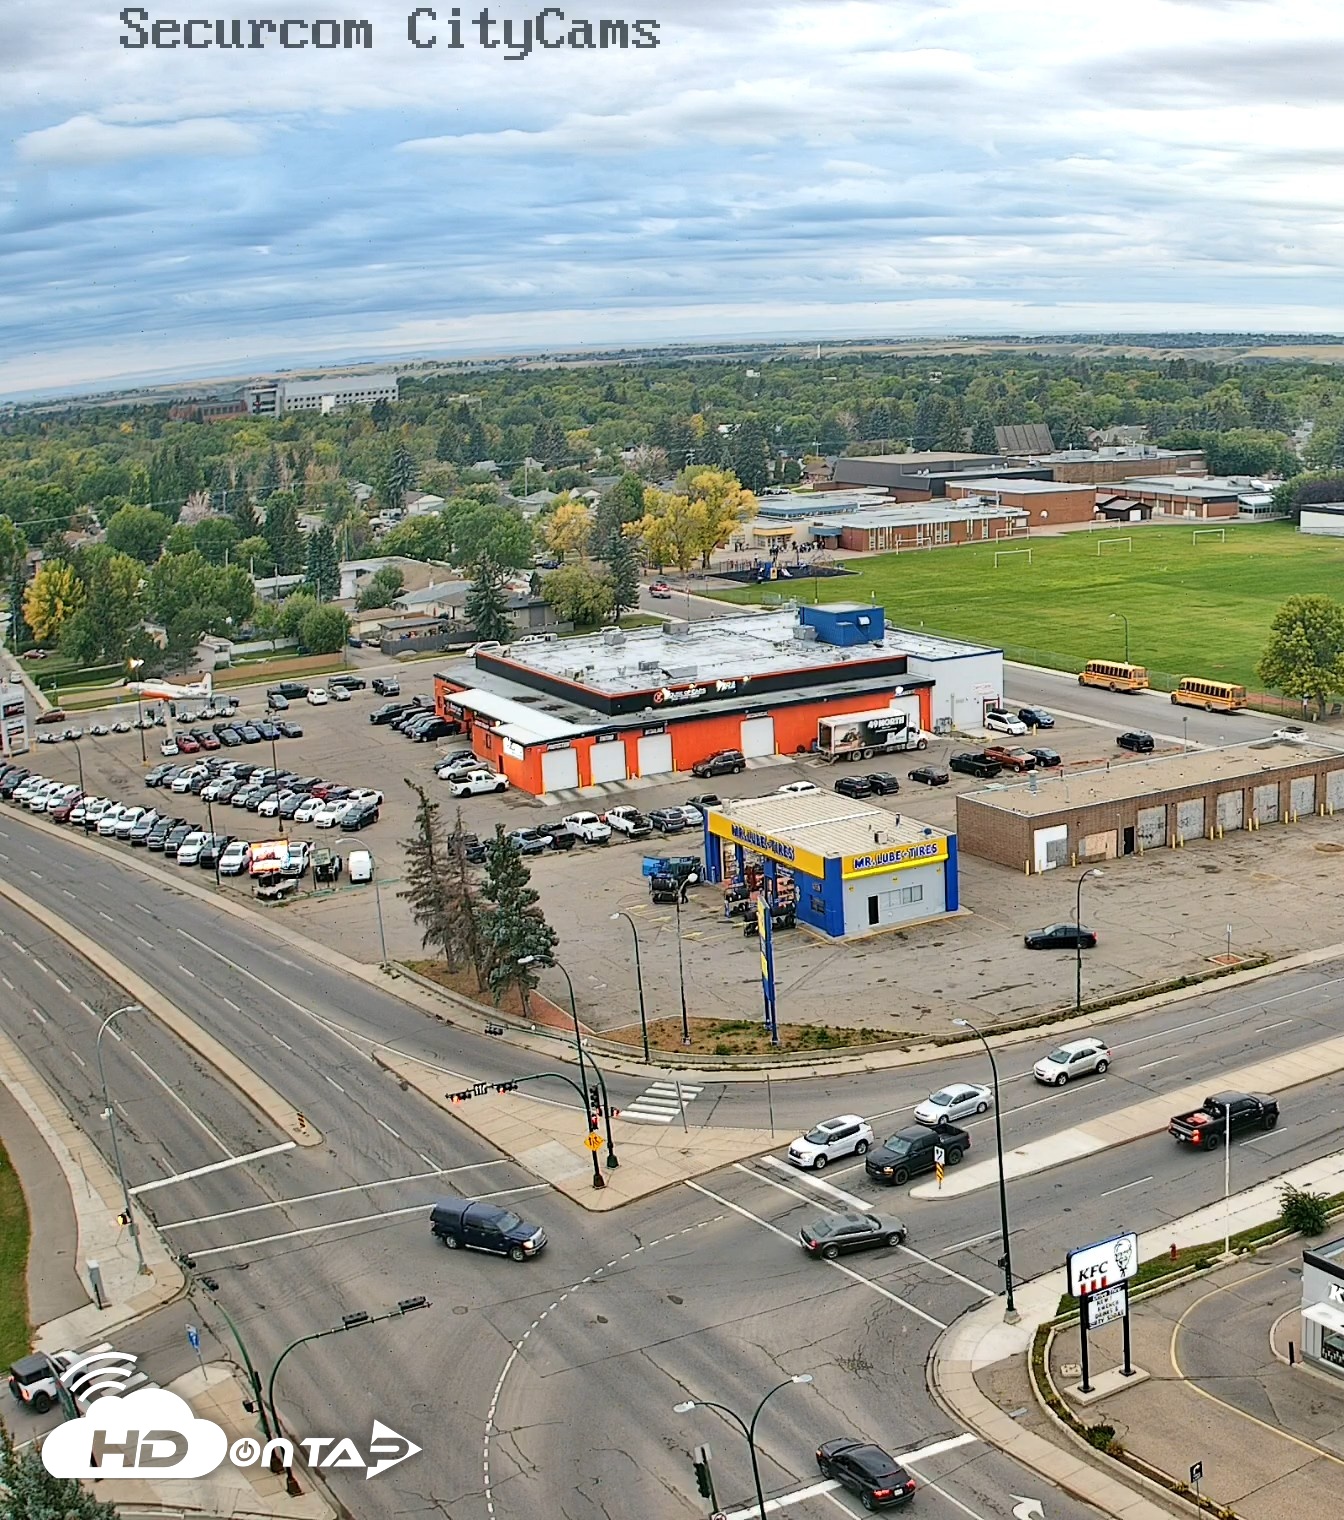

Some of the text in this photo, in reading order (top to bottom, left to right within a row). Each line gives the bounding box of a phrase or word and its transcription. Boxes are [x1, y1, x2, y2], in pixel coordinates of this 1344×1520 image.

[878, 715, 905, 728] NORTH
[854, 856, 876, 870] MR.
[877, 850, 902, 865] LUBE
[909, 843, 938, 859] TIRES
[1078, 1261, 1109, 1282] KFC
